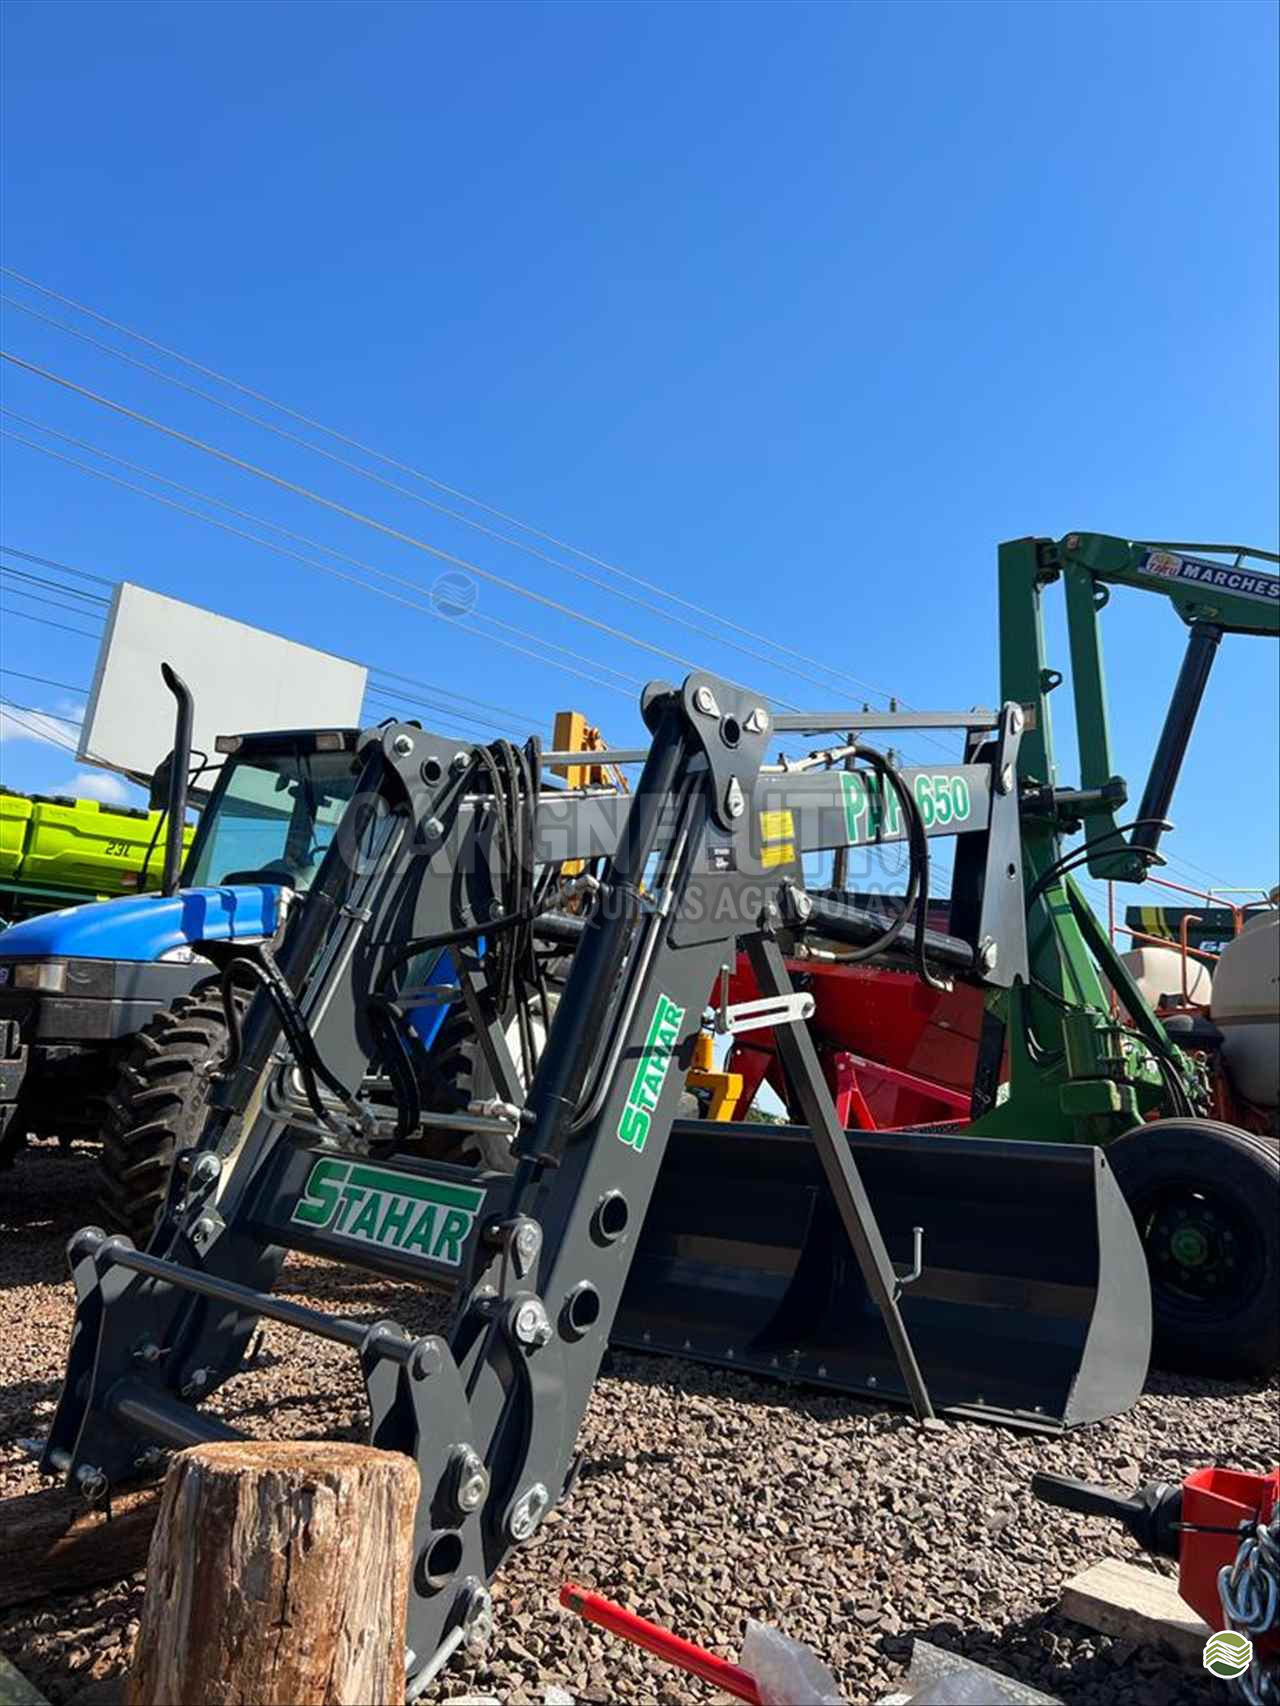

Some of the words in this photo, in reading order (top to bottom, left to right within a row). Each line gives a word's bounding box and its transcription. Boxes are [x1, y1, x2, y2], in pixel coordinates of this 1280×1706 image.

[914, 774, 970, 828] 650
[617, 993, 686, 1152] STAHAR
[291, 1157, 487, 1266] STAHAR
